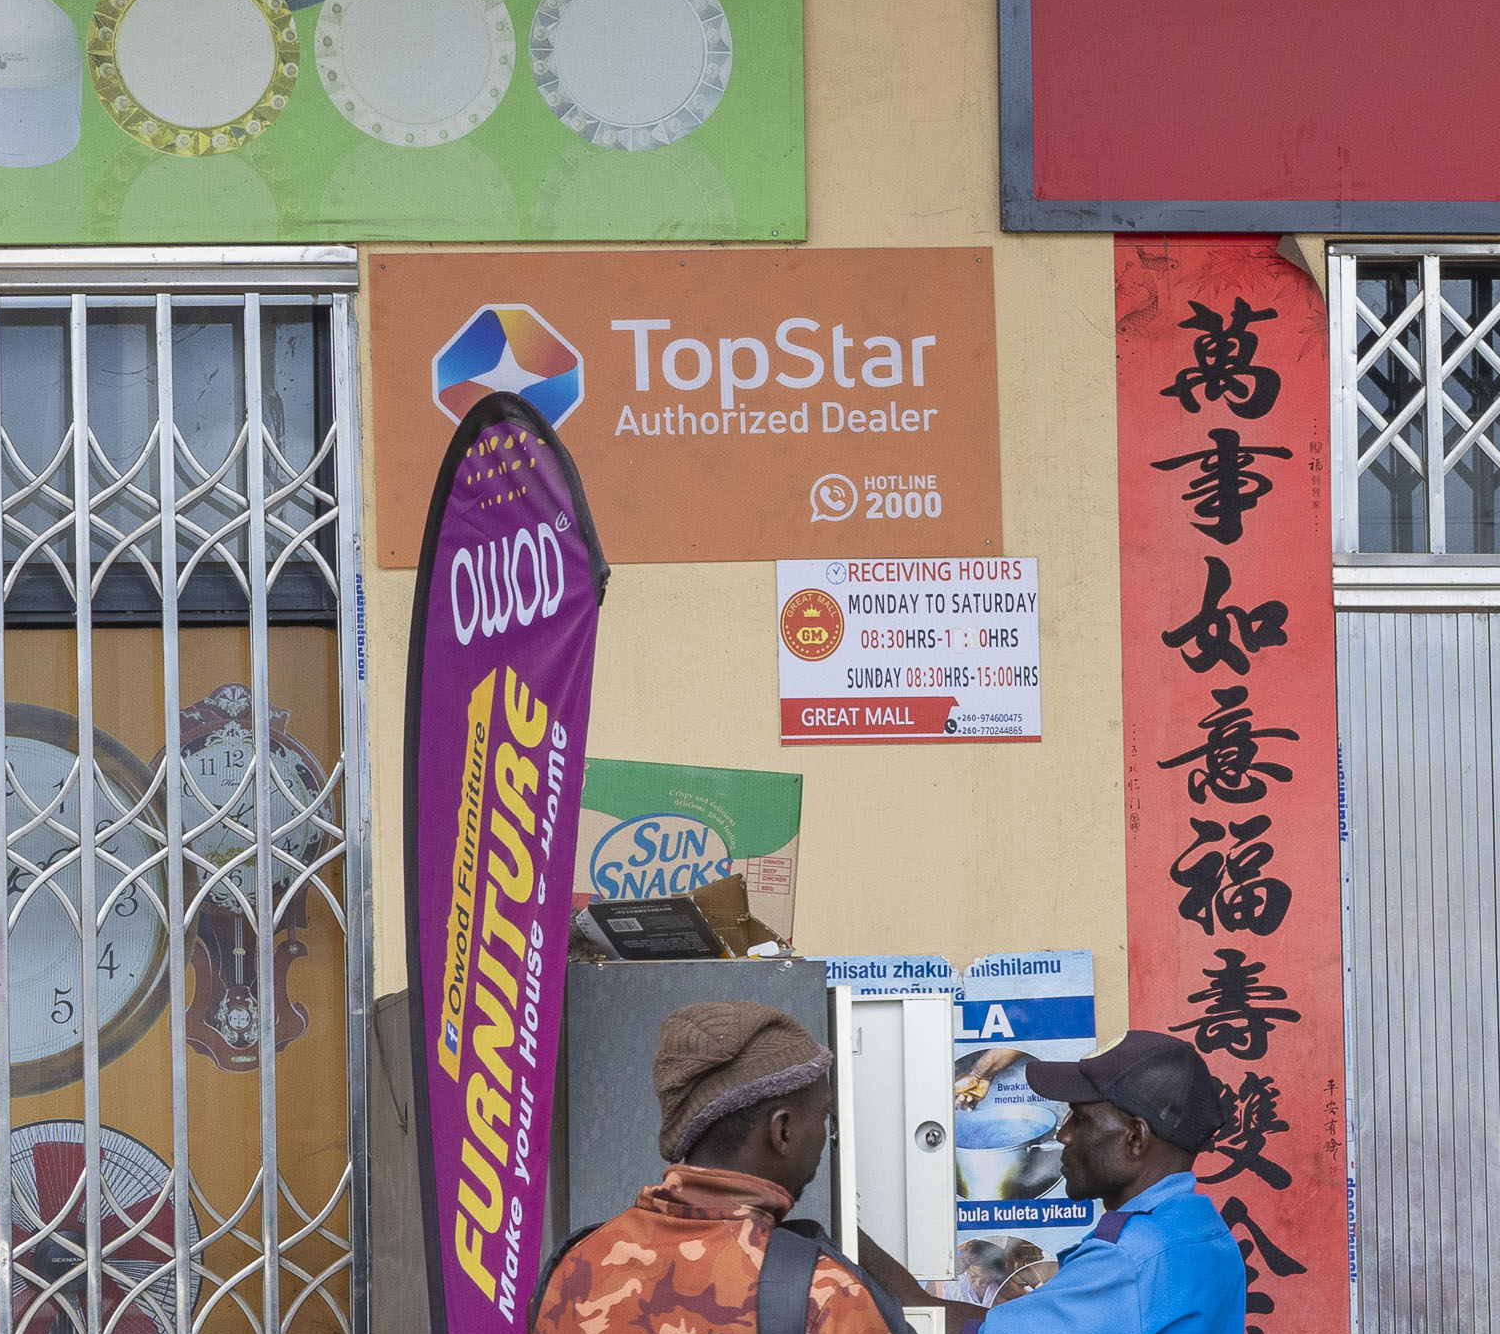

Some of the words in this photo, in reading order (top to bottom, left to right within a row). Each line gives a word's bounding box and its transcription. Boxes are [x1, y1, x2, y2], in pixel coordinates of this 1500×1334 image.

[611, 317, 937, 410] TopStar
[614, 403, 809, 438] Authorized
[820, 400, 939, 435] Dealer
[863, 474, 938, 491] HOTLINE
[864, 492, 942, 520] 2000
[848, 562, 952, 583] RECEIVING
[959, 560, 1023, 581] HOURS
[786, 593, 813, 618] GREAT
[817, 595, 837, 618] MALL
[848, 593, 920, 615] MONDAY
[925, 593, 946, 614] TO
[952, 592, 1037, 614] SATURDAY
[801, 629, 823, 642] GM
[847, 667, 902, 689] SUNDAY
[906, 665, 1039, 688] 08:30HRS-15:00HRS
[801, 707, 860, 727] GREAT
[865, 706, 915, 726] MALL
[956, 713, 1023, 723] +260-974600475
[957, 725, 1023, 735] +260-770244865
[200, 758, 216, 776] 11
[223, 749, 245, 768] 12
[541, 719, 568, 860] Home
[457, 721, 487, 903] Furniture
[628, 821, 709, 867] SUN
[762, 875, 787, 883] CHICKEN
[96, 941, 121, 980] 4
[447, 909, 472, 1018] Owod
[455, 665, 549, 1303] FURNITURE
[50, 986, 74, 1024] 5
[518, 926, 545, 1069] House
[994, 1093, 1025, 1105] menzhi
[514, 1083, 535, 1185] your
[993, 1205, 1039, 1222] kuleta
[1042, 1204, 1087, 1223] yikatu
[497, 1196, 522, 1325] Make
